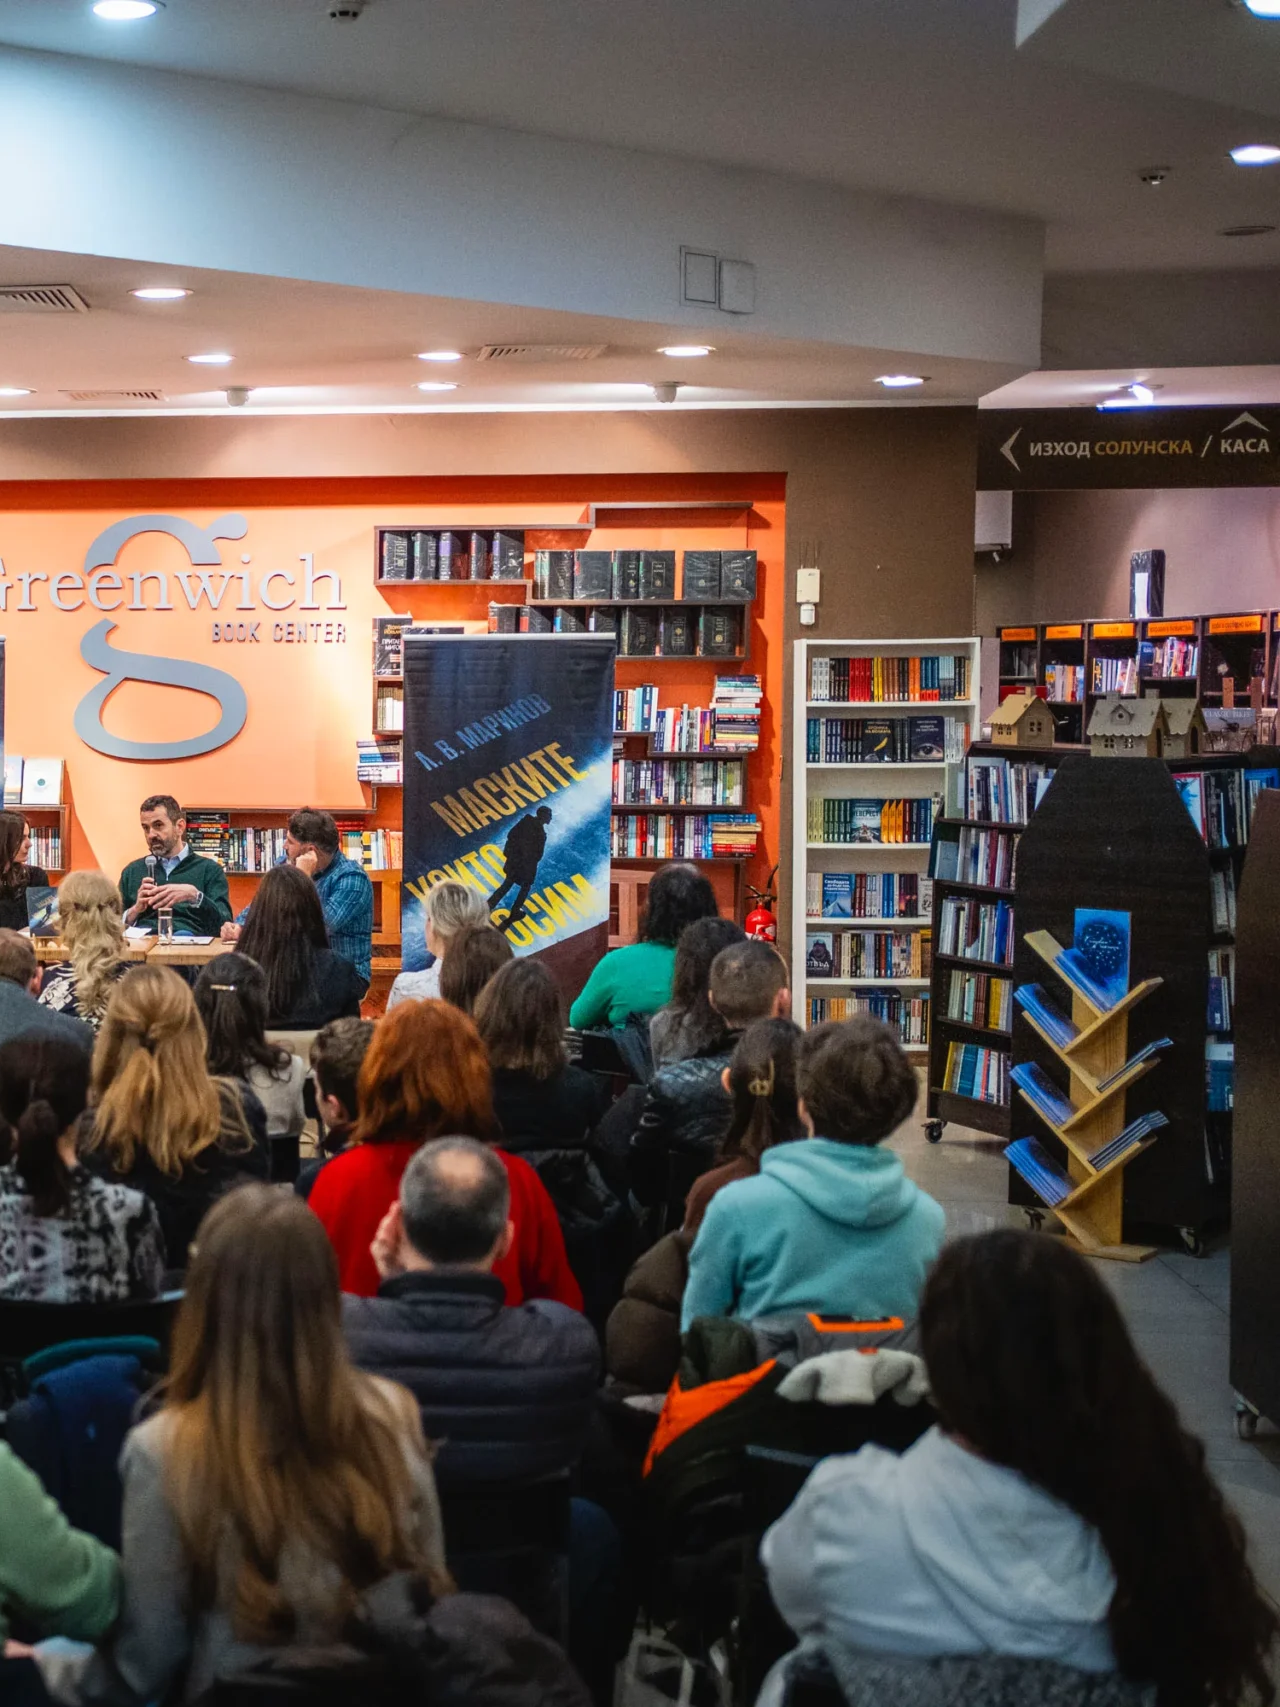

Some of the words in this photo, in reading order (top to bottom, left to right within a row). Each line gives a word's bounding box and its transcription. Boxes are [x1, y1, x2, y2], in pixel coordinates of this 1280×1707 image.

[1030, 441, 1091, 459] ИЗХОД
[1095, 440, 1193, 456] СОЛУНСКА
[1221, 438, 1270, 454] КАСА
[211, 622, 260, 643] BOOK
[273, 622, 347, 643] CENTER
[434, 739, 465, 761] В.
[455, 693, 552, 750] МАРИНОВ
[489, 873, 598, 947] ОСИМ
